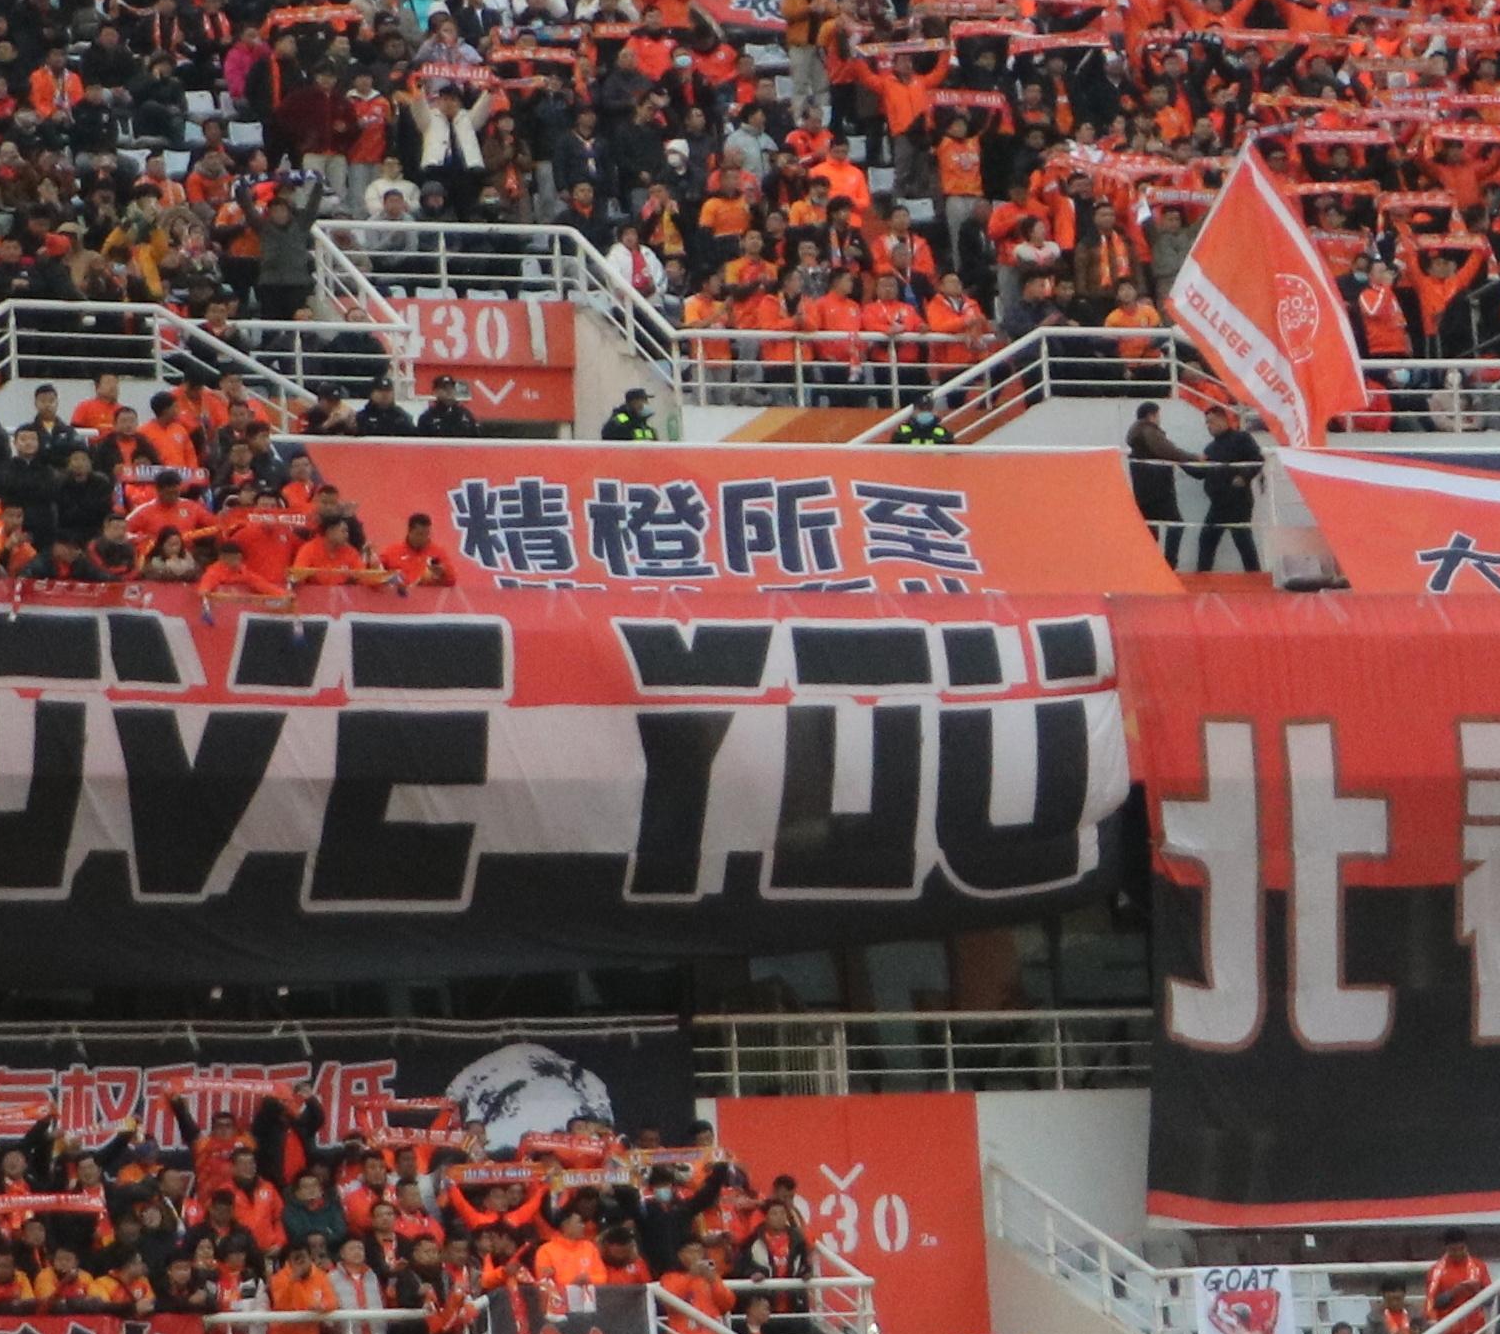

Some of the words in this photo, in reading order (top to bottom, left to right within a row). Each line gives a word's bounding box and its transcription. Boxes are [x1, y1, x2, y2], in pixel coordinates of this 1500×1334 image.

[448, 478, 971, 570] 精橙所至
[616, 609, 1123, 902] YOU
[1204, 1268, 1279, 1291] GOAT
